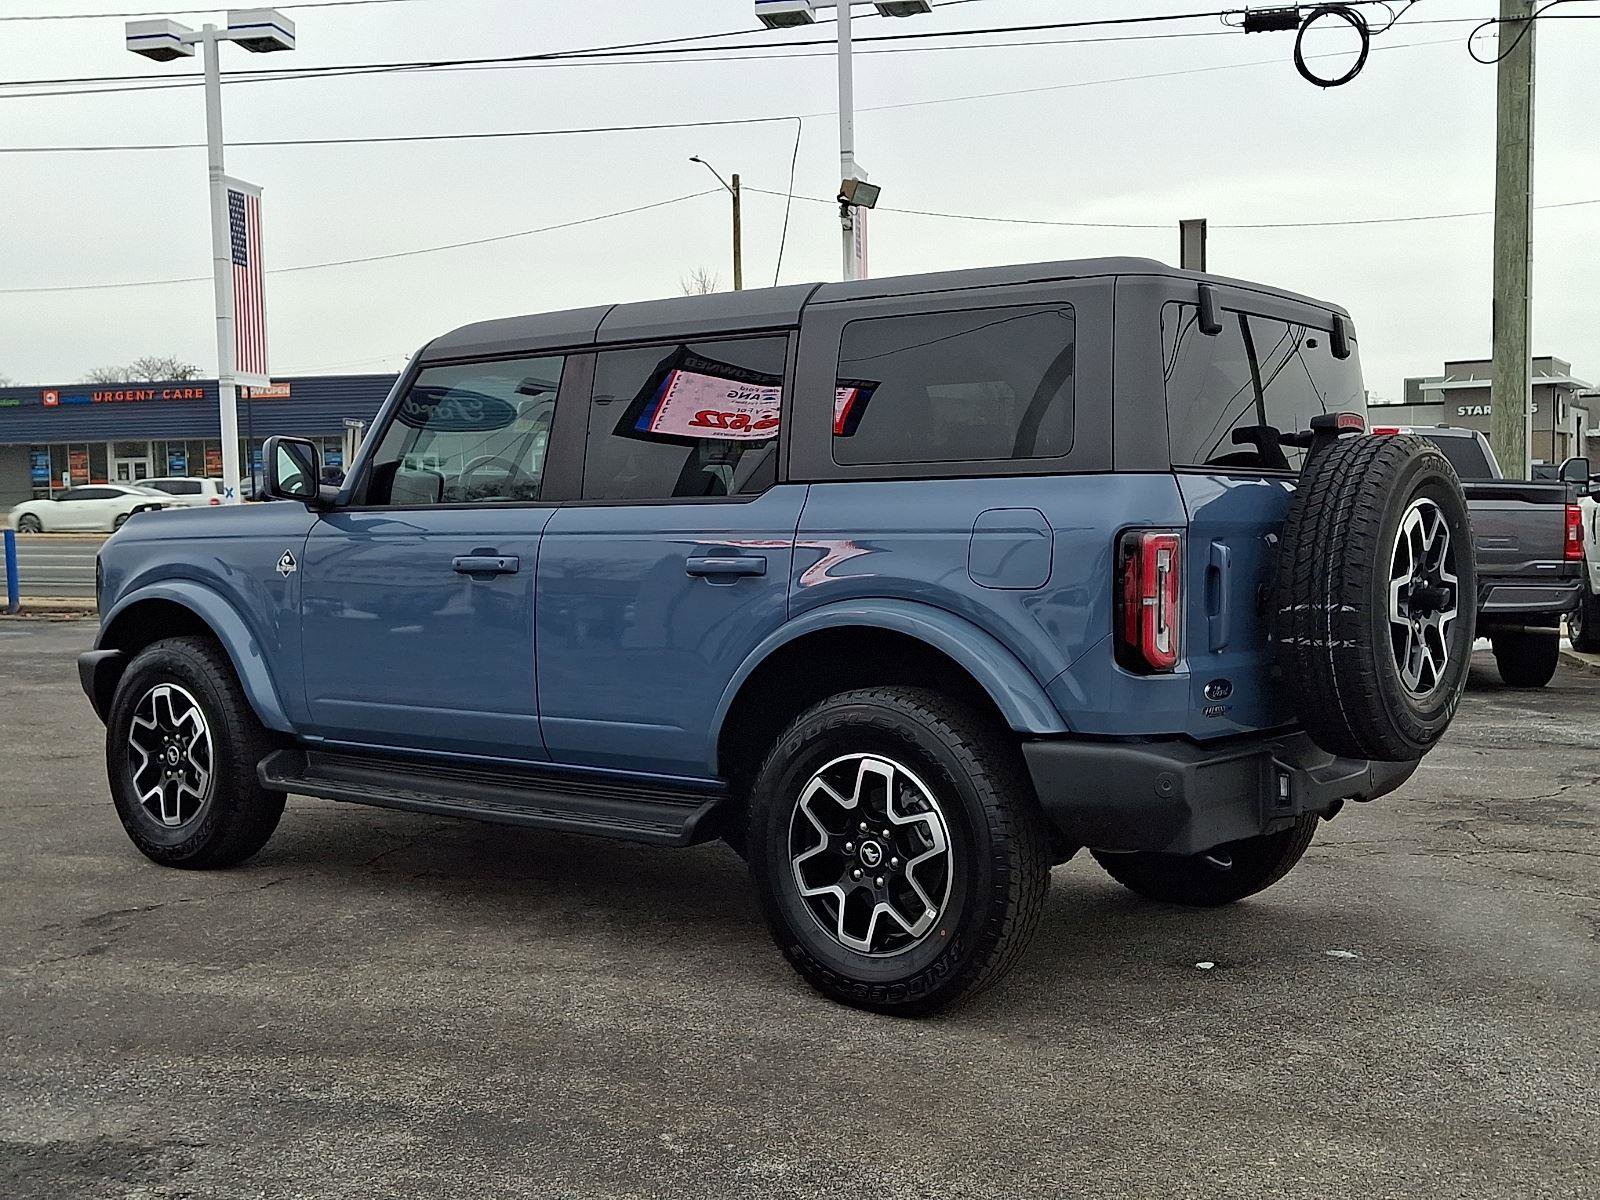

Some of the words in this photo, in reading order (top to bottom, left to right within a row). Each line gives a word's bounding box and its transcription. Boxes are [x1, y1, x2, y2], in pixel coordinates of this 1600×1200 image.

[93, 390, 155, 402] URGENT
[162, 388, 204, 400] CARE
[266, 384, 290, 395] OPEN
[1457, 404, 1538, 416] STARS
